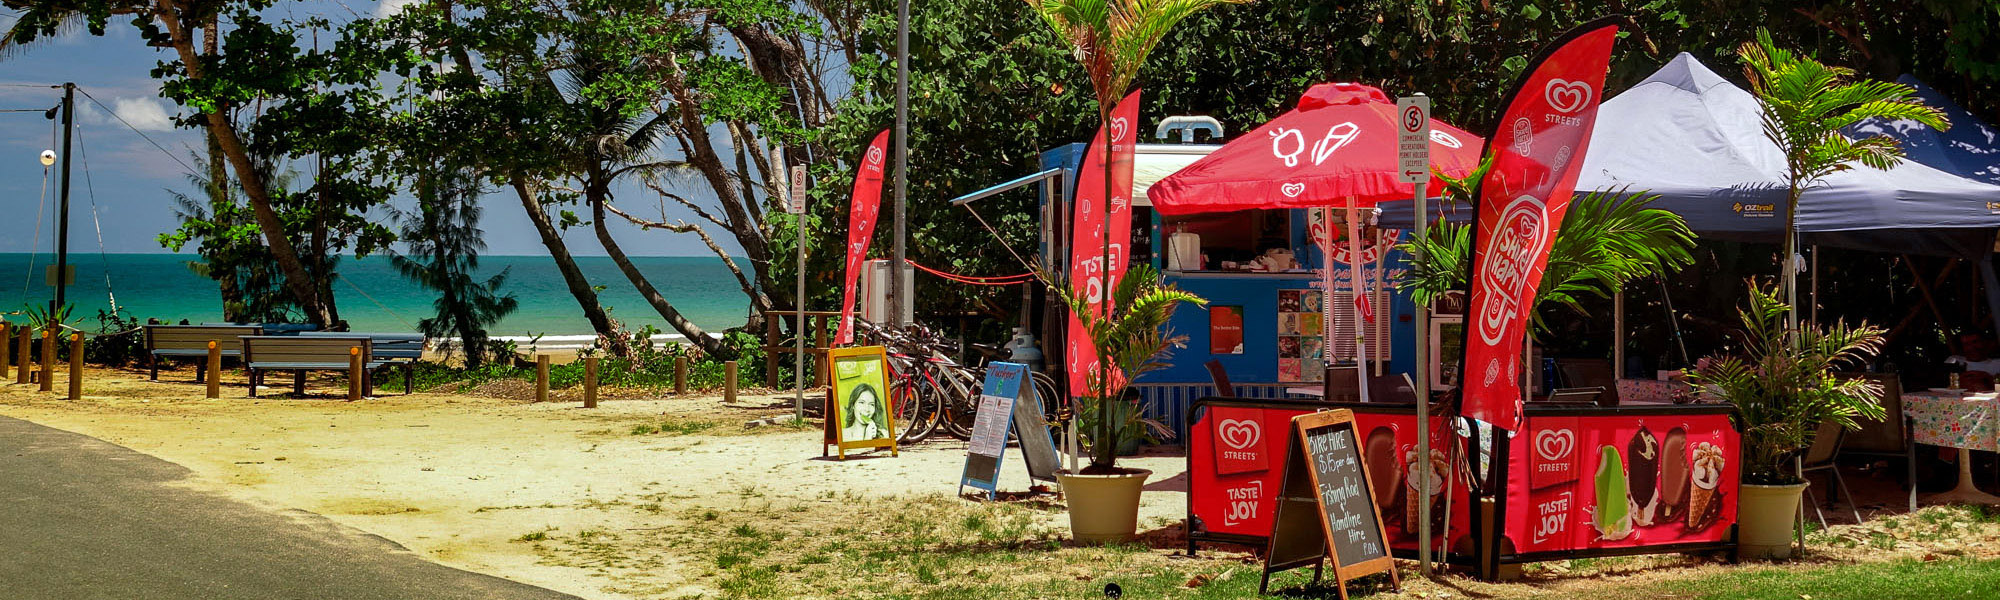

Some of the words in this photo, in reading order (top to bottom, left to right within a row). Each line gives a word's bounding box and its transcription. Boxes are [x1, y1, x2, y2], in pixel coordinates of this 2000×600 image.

[1545, 113, 1580, 127] STREETS
[1224, 451, 1256, 460] STREETS
[1319, 452, 1337, 475] $15
[1336, 458, 1345, 473] per
[1346, 453, 1356, 472] day
[1538, 463, 1568, 472] STREETS
[1227, 487, 1258, 500] TASTE
[1319, 482, 1347, 506] Fishing
[1343, 476, 1360, 498] Rod
[1228, 500, 1259, 520] JOY
[1538, 499, 1568, 515] TASTE
[1329, 510, 1362, 532] Handline
[1538, 513, 1567, 536] JOY
[1348, 528, 1366, 544] Hire
